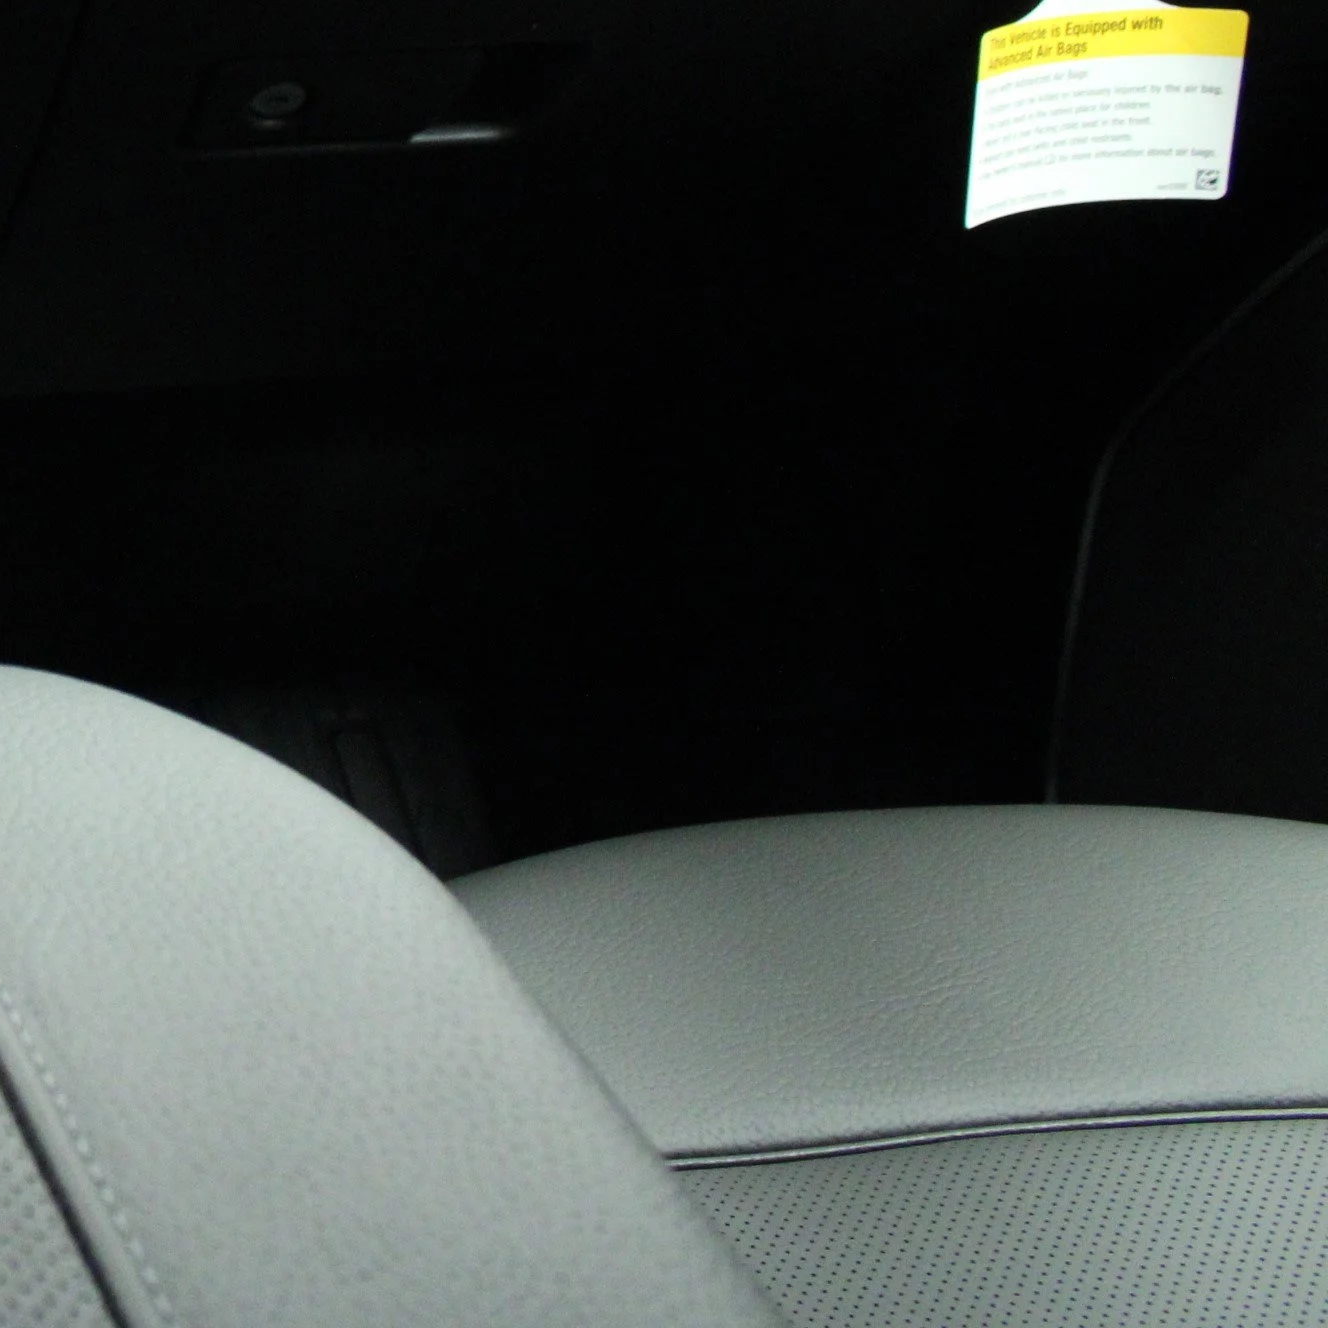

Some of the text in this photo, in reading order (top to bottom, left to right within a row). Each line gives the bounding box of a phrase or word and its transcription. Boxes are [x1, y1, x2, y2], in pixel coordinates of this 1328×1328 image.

[1051, 24, 1061, 38] is
[1064, 18, 1127, 38] Equipped
[1130, 15, 1164, 31] with
[1036, 43, 1054, 59] Air
[1056, 40, 1089, 59] Bags
